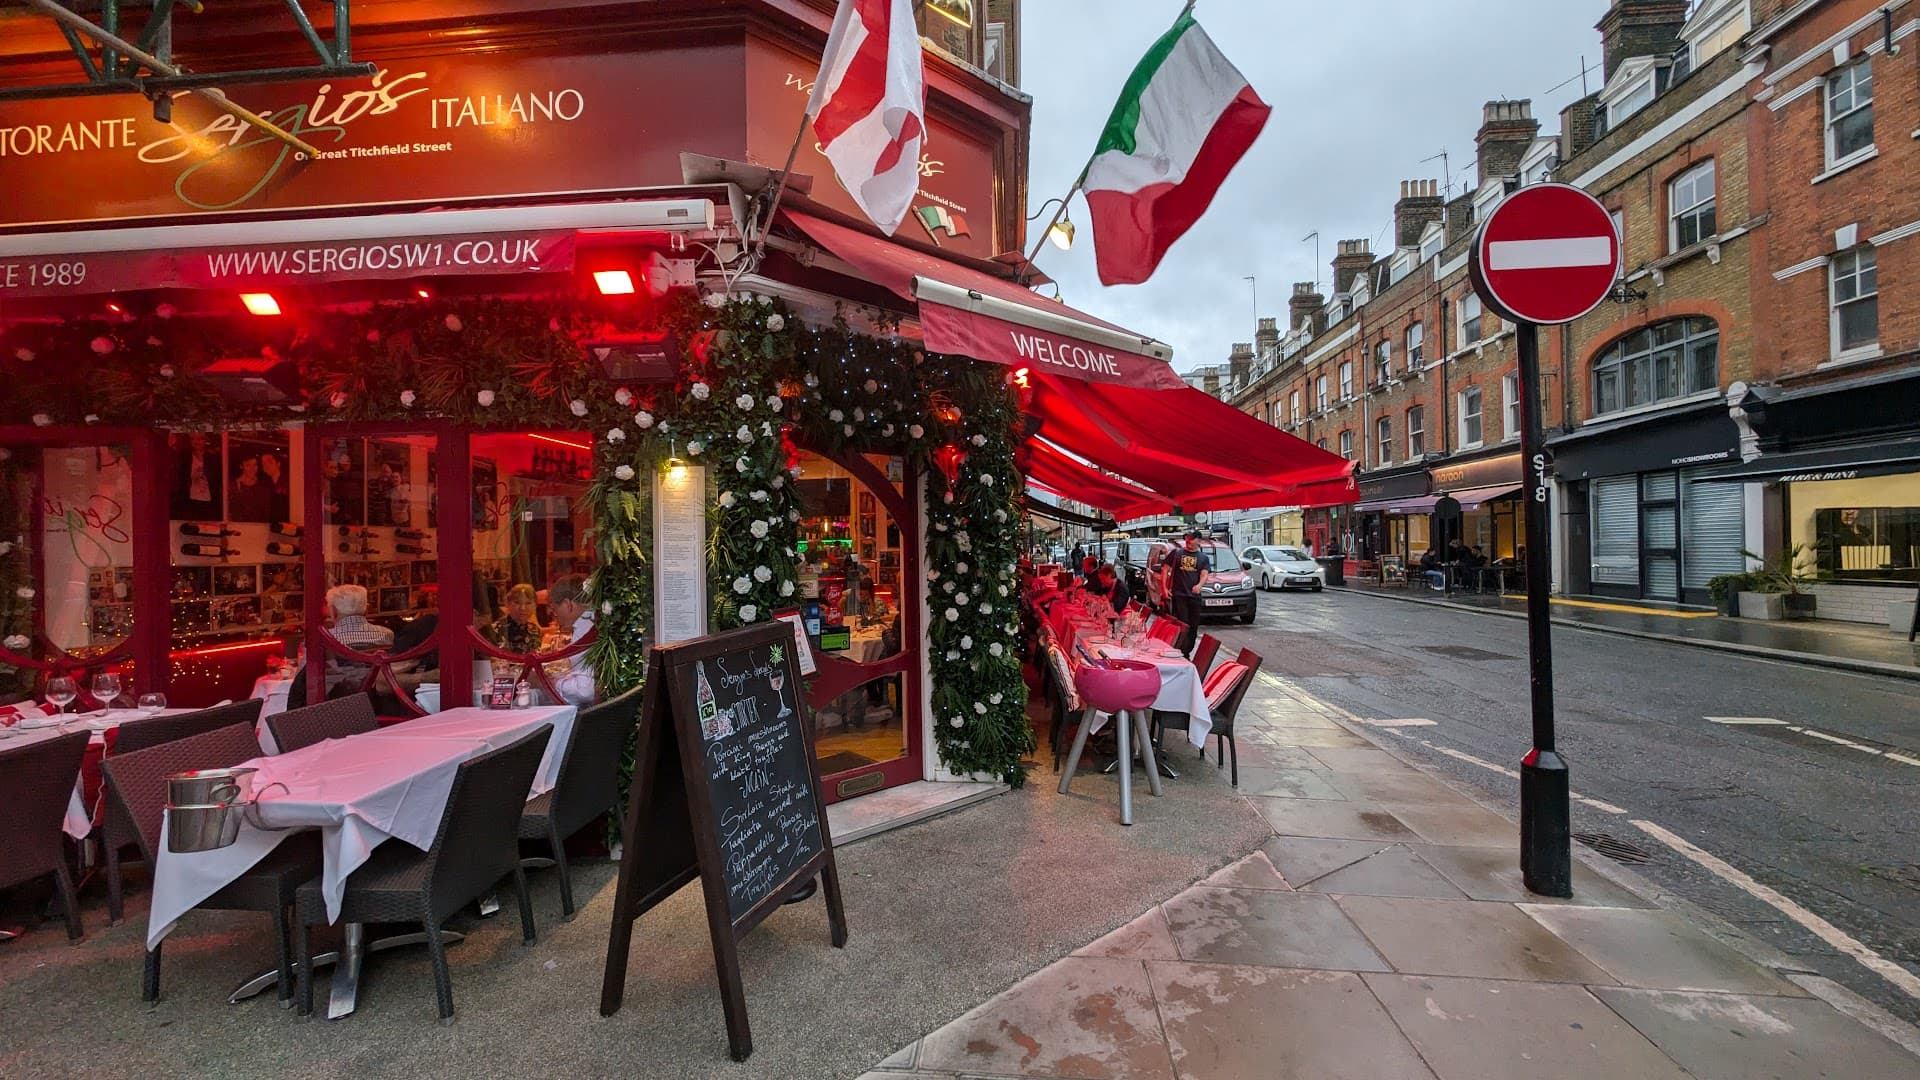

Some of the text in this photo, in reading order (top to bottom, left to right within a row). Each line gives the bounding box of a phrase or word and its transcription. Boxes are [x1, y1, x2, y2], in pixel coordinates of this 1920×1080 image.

[431, 89, 584, 128] ITALIANO
[349, 144, 410, 158] Titchfield
[413, 141, 452, 153] Street
[920, 190, 948, 205] Titchfield
[949, 201, 966, 213] Street
[207, 239, 541, 279] WWW.SERGIOSW1.CO.UK
[28, 262, 86, 286] 1989
[1010, 331, 1121, 376] WELCOME
[1435, 471, 1464, 482] naroon
